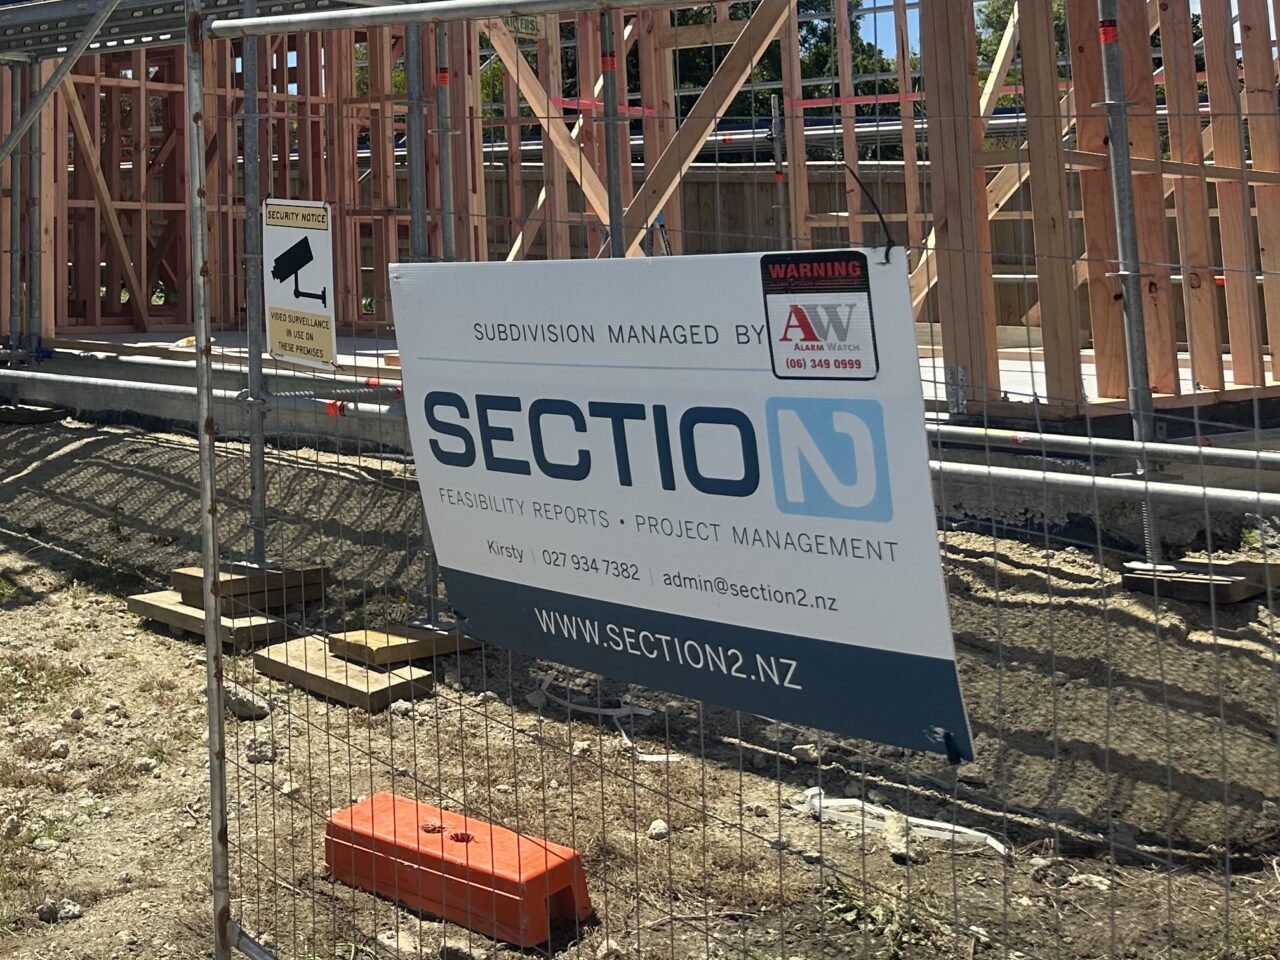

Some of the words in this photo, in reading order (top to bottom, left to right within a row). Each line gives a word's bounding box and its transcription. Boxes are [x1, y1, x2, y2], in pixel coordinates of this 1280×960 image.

[267, 210, 300, 221] SECURITY
[301, 213, 326, 224] NOTICE
[768, 261, 862, 279] WARNING
[270, 312, 287, 322] VIDEO
[287, 314, 330, 330] SURVEILLANCE
[779, 303, 857, 342] AW
[286, 329, 292, 337] IN
[293, 330, 305, 340] USE
[305, 332, 314, 342] ON
[473, 322, 595, 343] SUBDIVISION
[607, 324, 719, 345] MANAGED
[735, 324, 766, 345] BY
[278, 341, 295, 353] THESE
[295, 344, 324, 359] PREMISES
[785, 357, 807, 369] (06)
[810, 358, 831, 369] 349
[833, 358, 862, 369] 0999
[439, 487, 524, 516] FEASIBILITY
[533, 501, 610, 528] REPORTS
[635, 514, 720, 542] PROJECT
[732, 526, 898, 562] MANAGEMENT
[486, 539, 524, 564] Kirsty
[542, 549, 566, 567] 027
[571, 554, 599, 574] 934
[602, 559, 641, 581] 7382
[663, 571, 839, 612] admin@section2.nz
[534, 607, 803, 691] WWW.SECTION2.NZ
